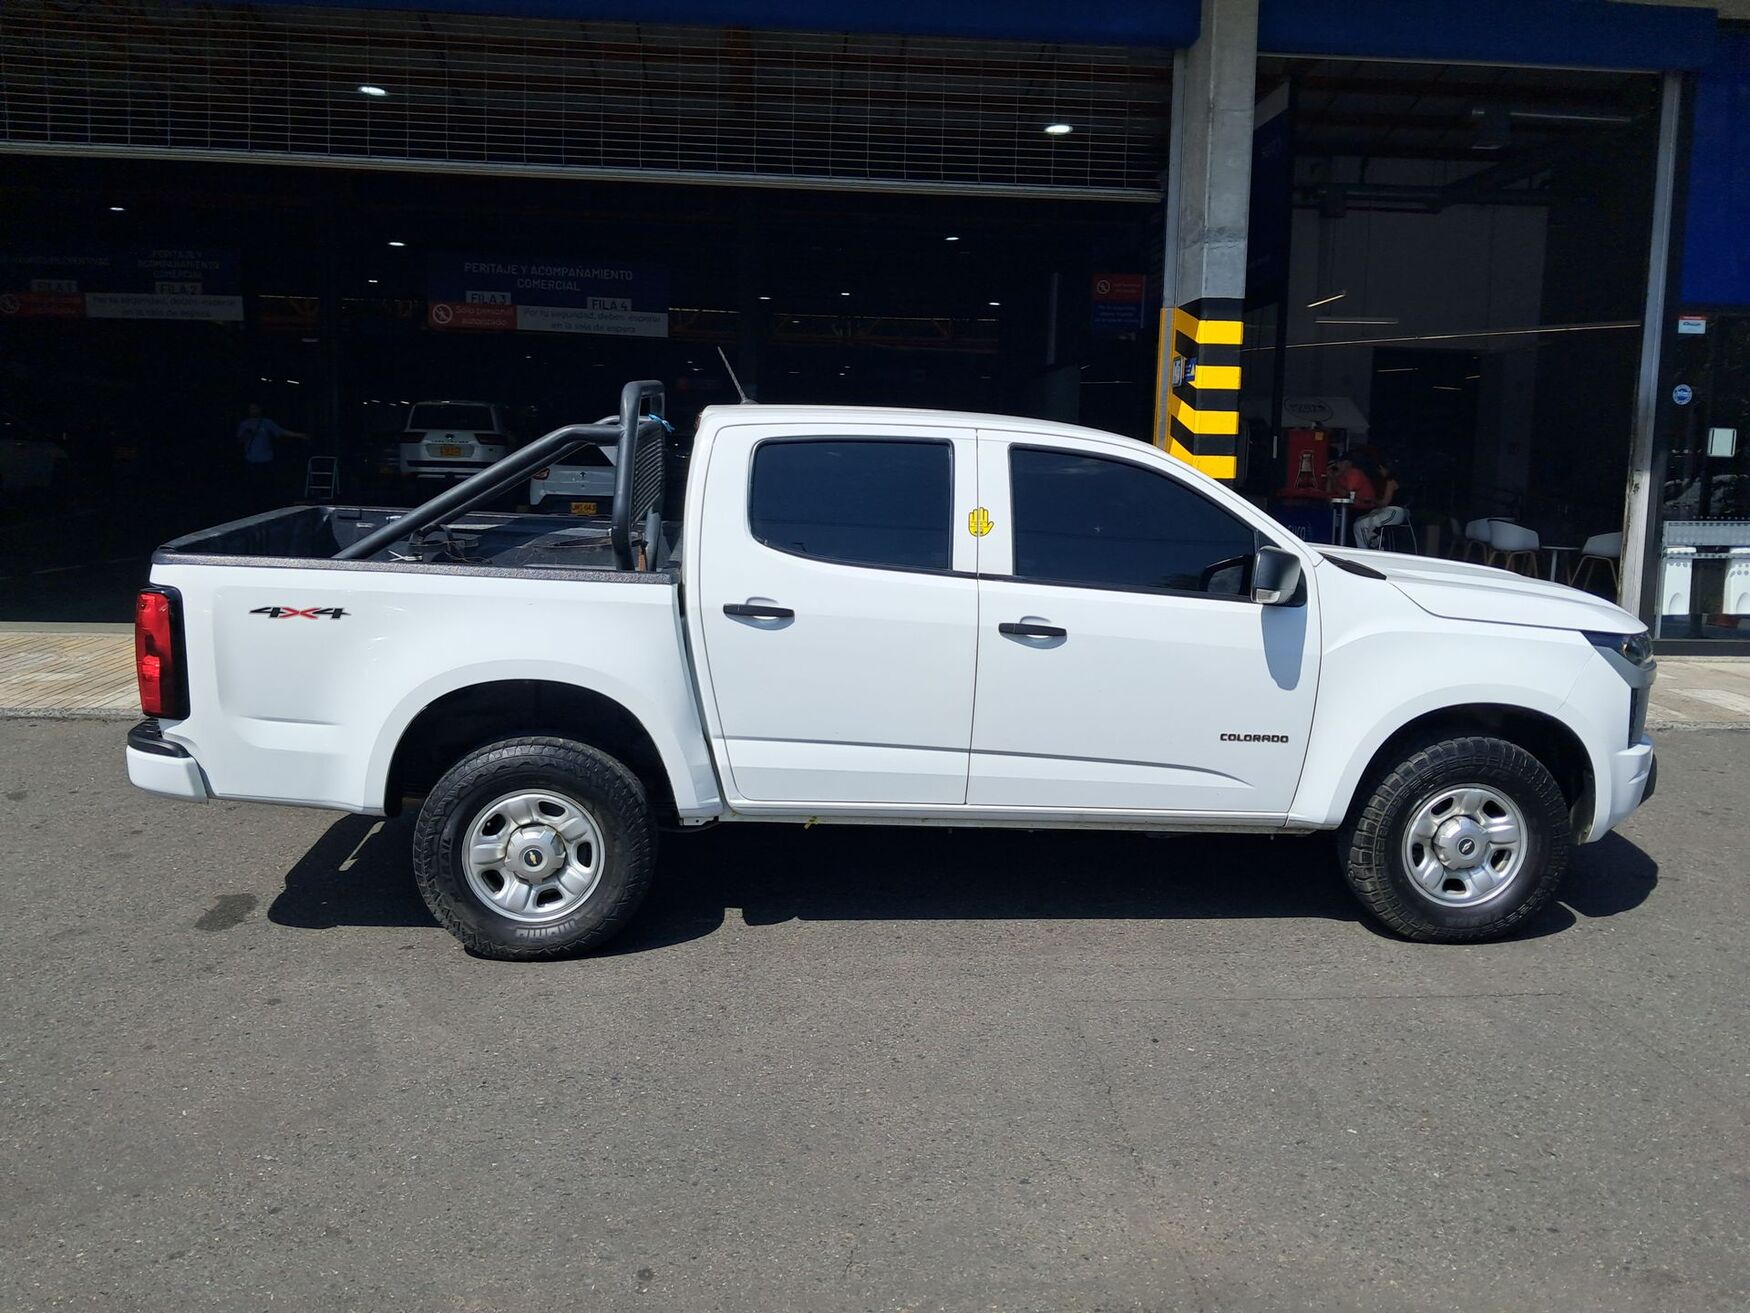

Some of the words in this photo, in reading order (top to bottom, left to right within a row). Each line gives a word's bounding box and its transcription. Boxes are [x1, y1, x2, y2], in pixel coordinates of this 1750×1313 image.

[464, 262, 518, 275] PERITAJE
[520, 264, 528, 275] Y
[531, 264, 633, 281] ACOMPAÑAMIENTO
[516, 278, 581, 291] COMERCIAL
[471, 293, 498, 305] FILA
[592, 299, 617, 311] FILA
[621, 300, 628, 311] 4
[1220, 733, 1289, 744] COLORADO
